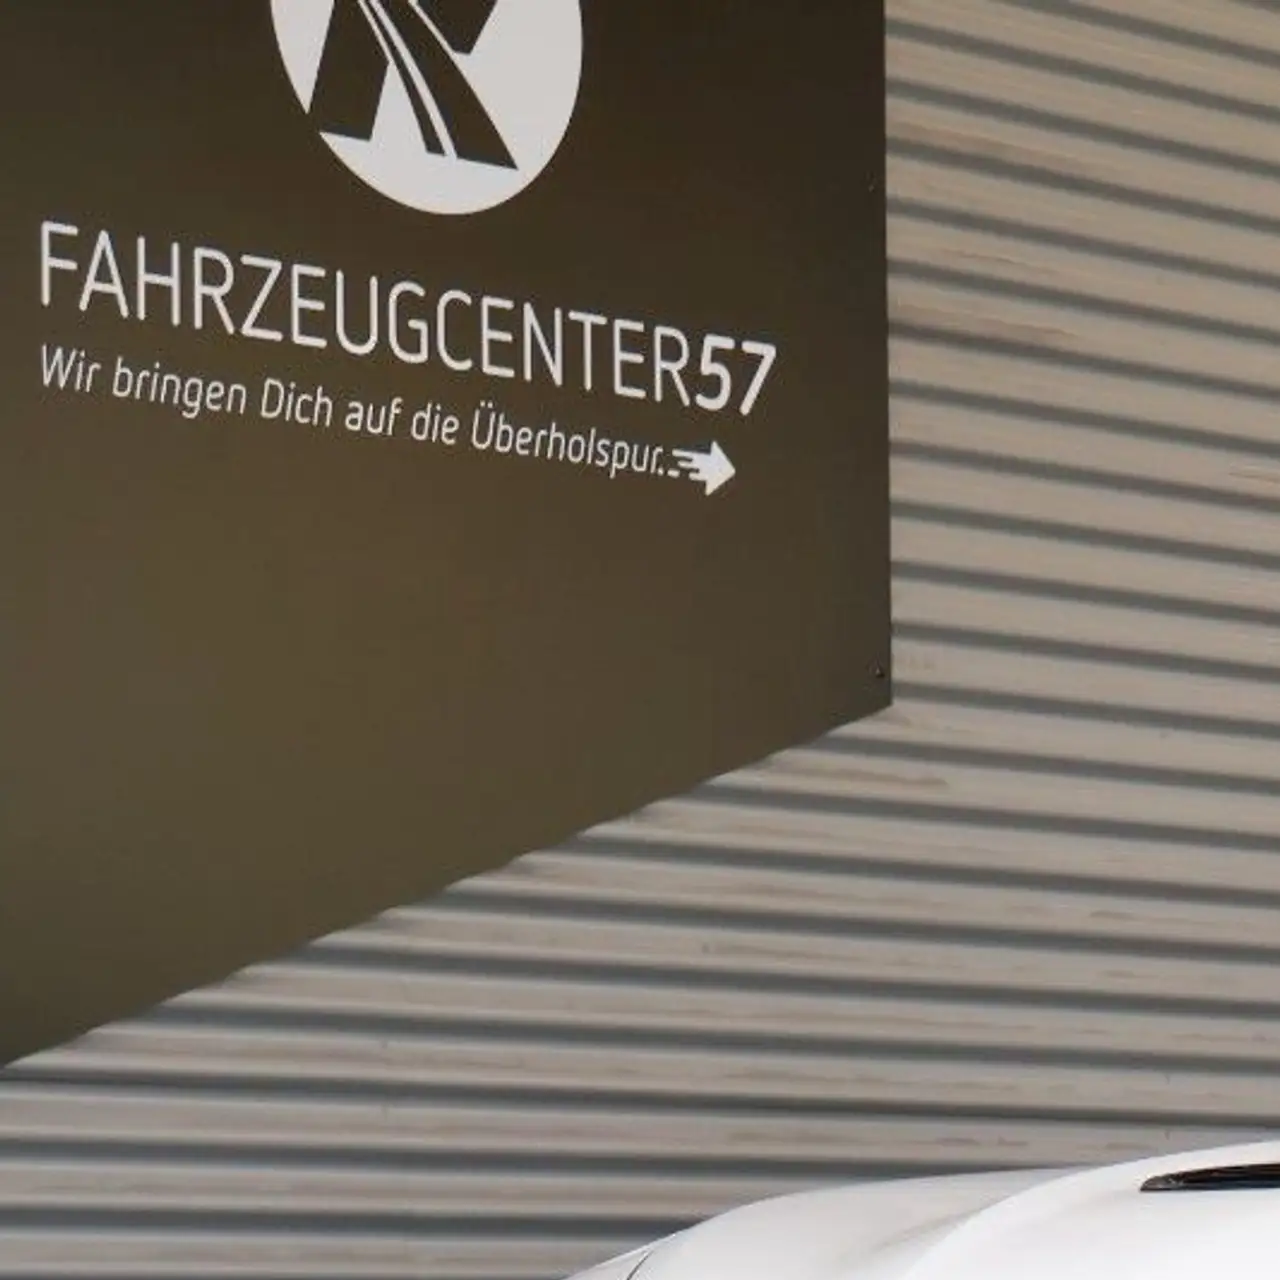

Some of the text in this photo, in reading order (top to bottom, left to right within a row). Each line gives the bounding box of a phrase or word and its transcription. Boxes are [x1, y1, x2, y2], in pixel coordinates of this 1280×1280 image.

[39, 219, 777, 416] FAHRZEUGCENTER57
[41, 343, 102, 393] Wir
[112, 355, 247, 419] bringen
[260, 377, 333, 427] Dich
[345, 396, 403, 436] auf
[411, 402, 460, 445] die
